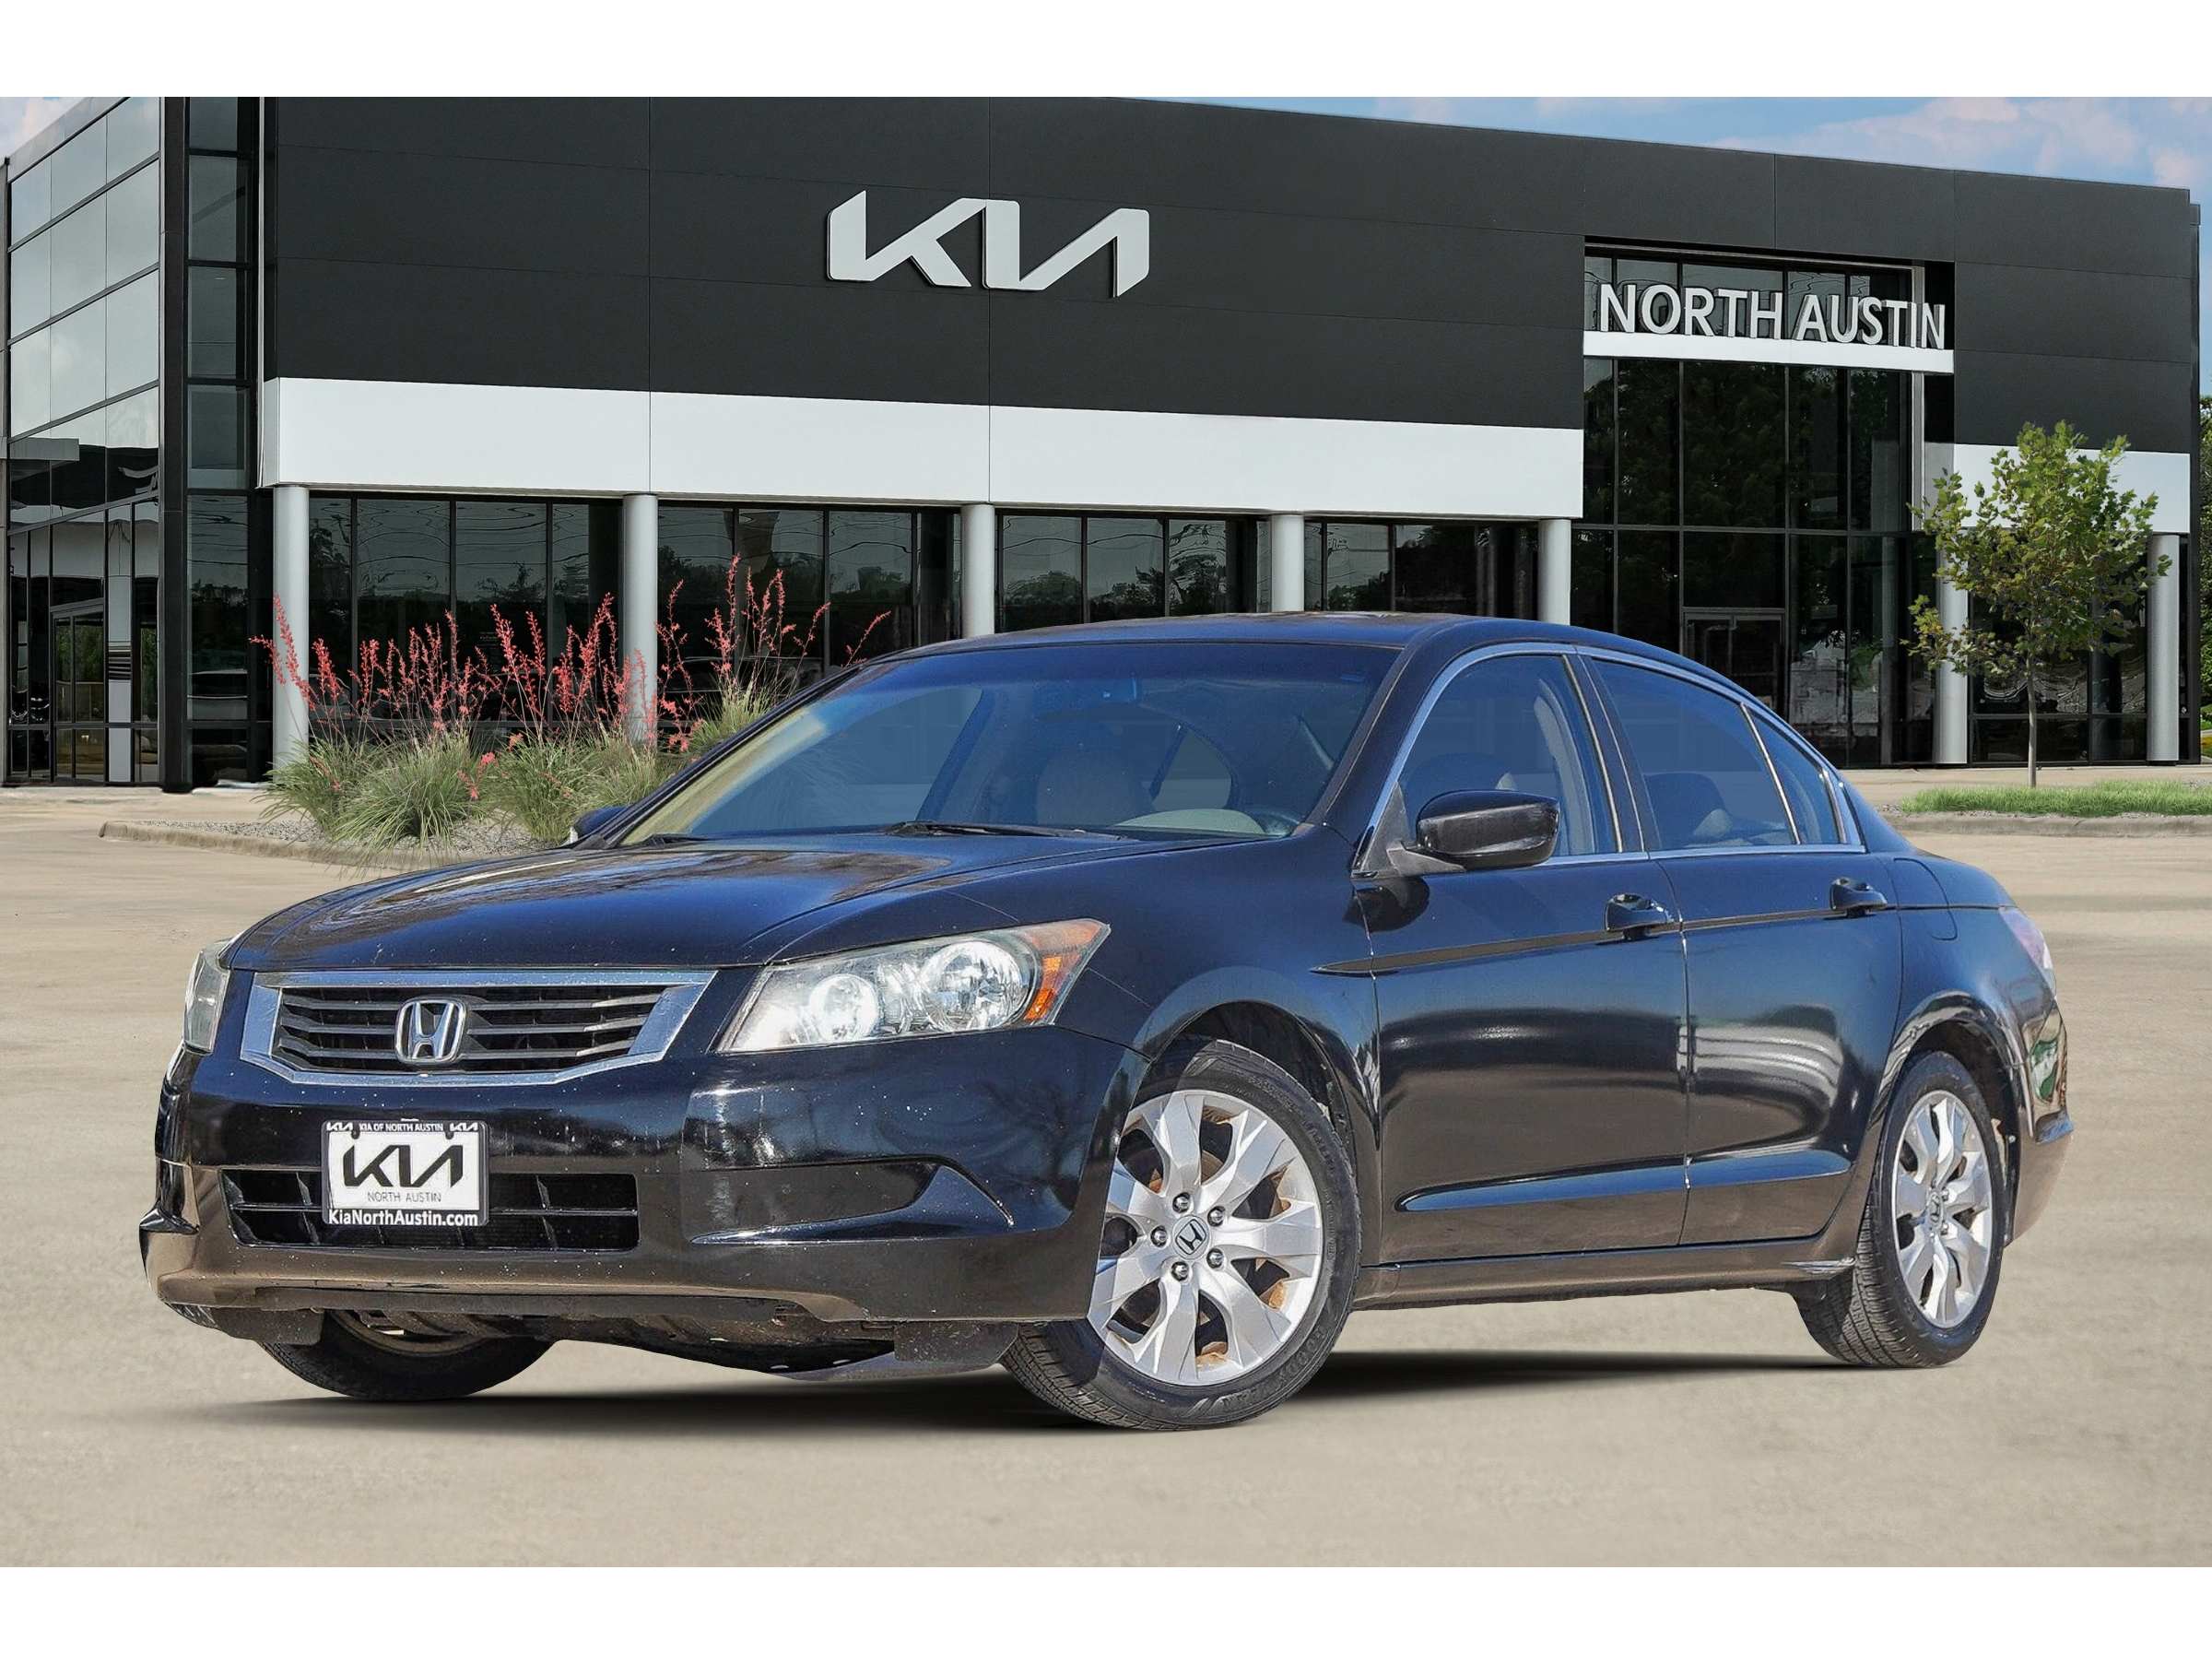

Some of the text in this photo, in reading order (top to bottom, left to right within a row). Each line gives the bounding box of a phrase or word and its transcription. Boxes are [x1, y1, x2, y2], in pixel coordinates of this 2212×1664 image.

[826, 190, 1150, 298] KIA
[1598, 284, 1946, 349] NORTH AUSTIN
[326, 1122, 353, 1131] KIA
[359, 1123, 443, 1132] KIA OF NORTH AUSTIN
[450, 1122, 478, 1131] KIA
[343, 1145, 463, 1187] KIA
[367, 1192, 441, 1203] NORTH AUSTIN
[328, 1210, 478, 1226] KiaNorthAustin.com
